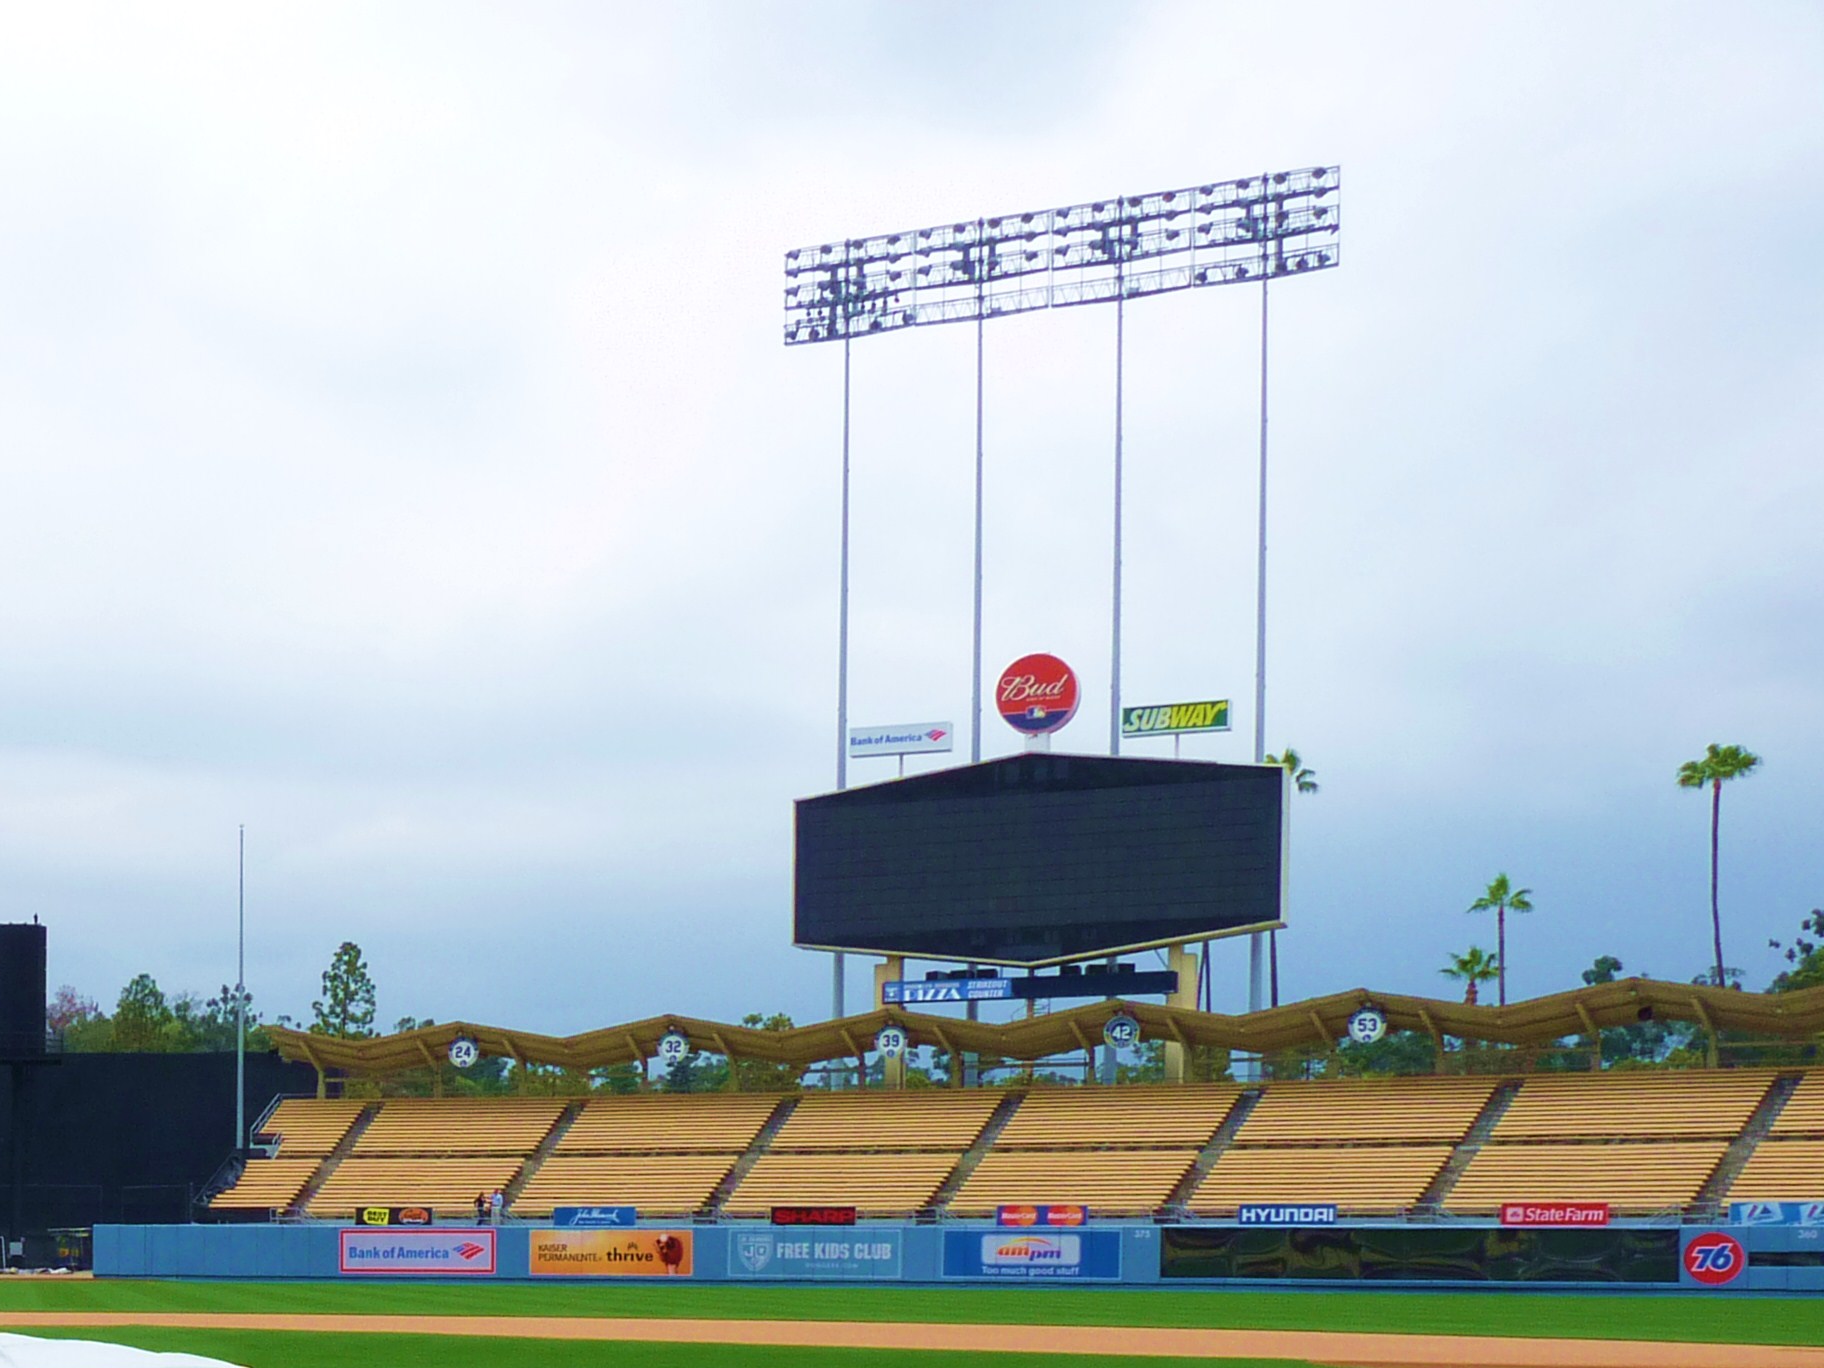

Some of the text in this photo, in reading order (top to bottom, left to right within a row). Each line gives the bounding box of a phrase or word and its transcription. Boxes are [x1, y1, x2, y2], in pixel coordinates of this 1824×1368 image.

[1001, 674, 1069, 701] Bud
[1122, 701, 1228, 732] SUBWAY
[850, 733, 923, 746] Bank of America
[903, 987, 961, 1001] PIZZA
[1112, 1025, 1131, 1039] 42
[1358, 1018, 1378, 1032] 53
[665, 1039, 681, 1053] 32
[883, 1034, 899, 1048] 39
[455, 1046, 471, 1060] 24
[775, 1209, 854, 1223] SHARP
[1241, 1208, 1334, 1222] HYUNDAI
[1797, 1230, 1818, 1239] 360
[349, 1247, 449, 1259] Bank of America
[538, 1244, 568, 1252] KAISER
[606, 1247, 654, 1262] thrive
[776, 1243, 892, 1259] FREE KIDS CLUB
[997, 1246, 1061, 1261] ampm
[1690, 1243, 1734, 1272] 76
[982, 1266, 1080, 1276] Too much good stuff
